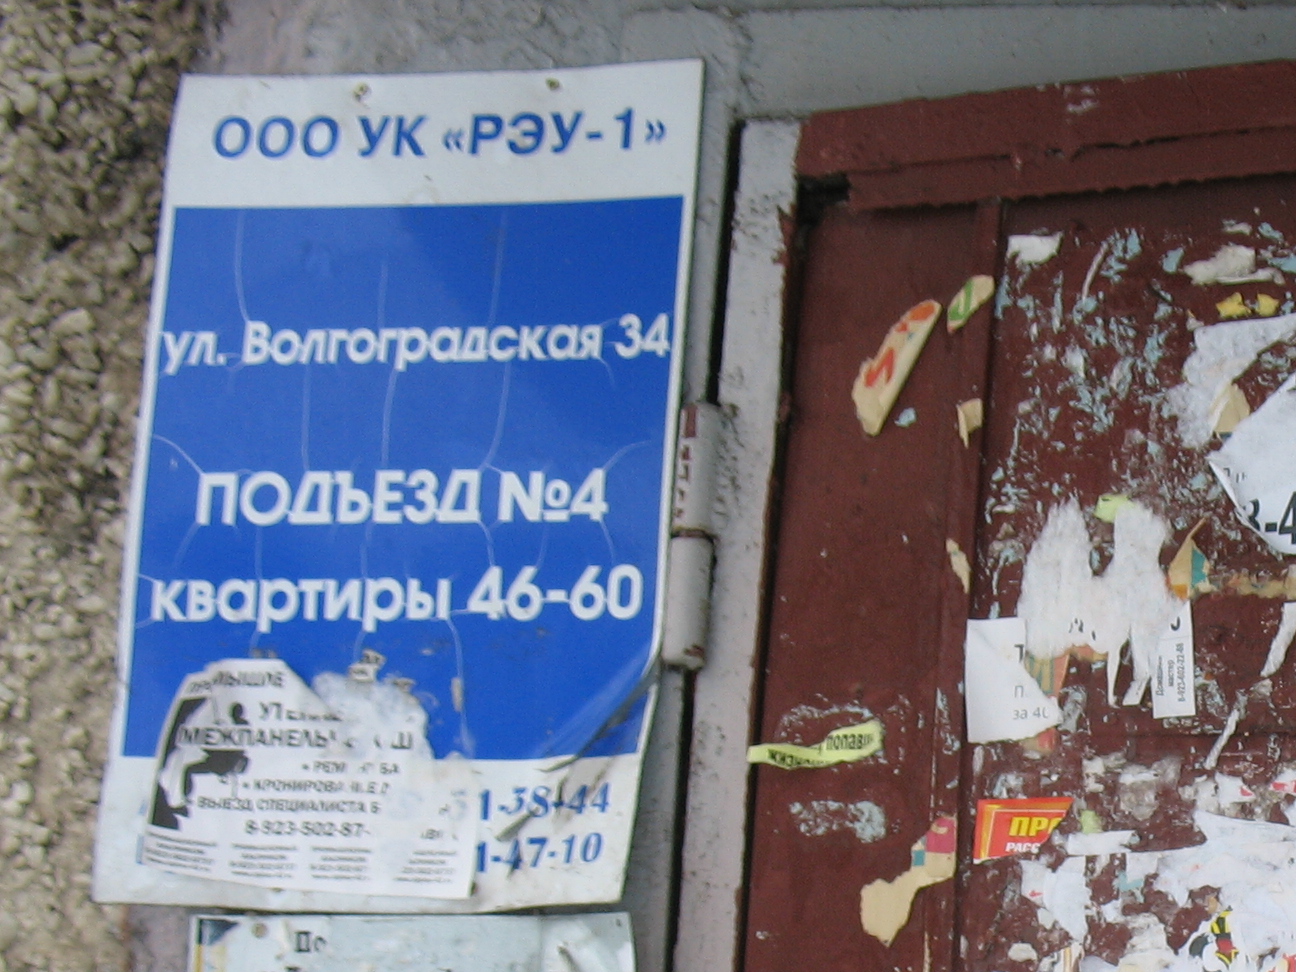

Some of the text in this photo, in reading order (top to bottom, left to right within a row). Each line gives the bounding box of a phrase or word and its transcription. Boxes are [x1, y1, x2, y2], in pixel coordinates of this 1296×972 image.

[213, 108, 668, 159] ООО УК «РЭУ-1»
[162, 313, 672, 375] ул. Волгоградская 34
[195, 469, 609, 526] ПОДЪЕЗД №4
[149, 563, 643, 633] квартиры 46-60
